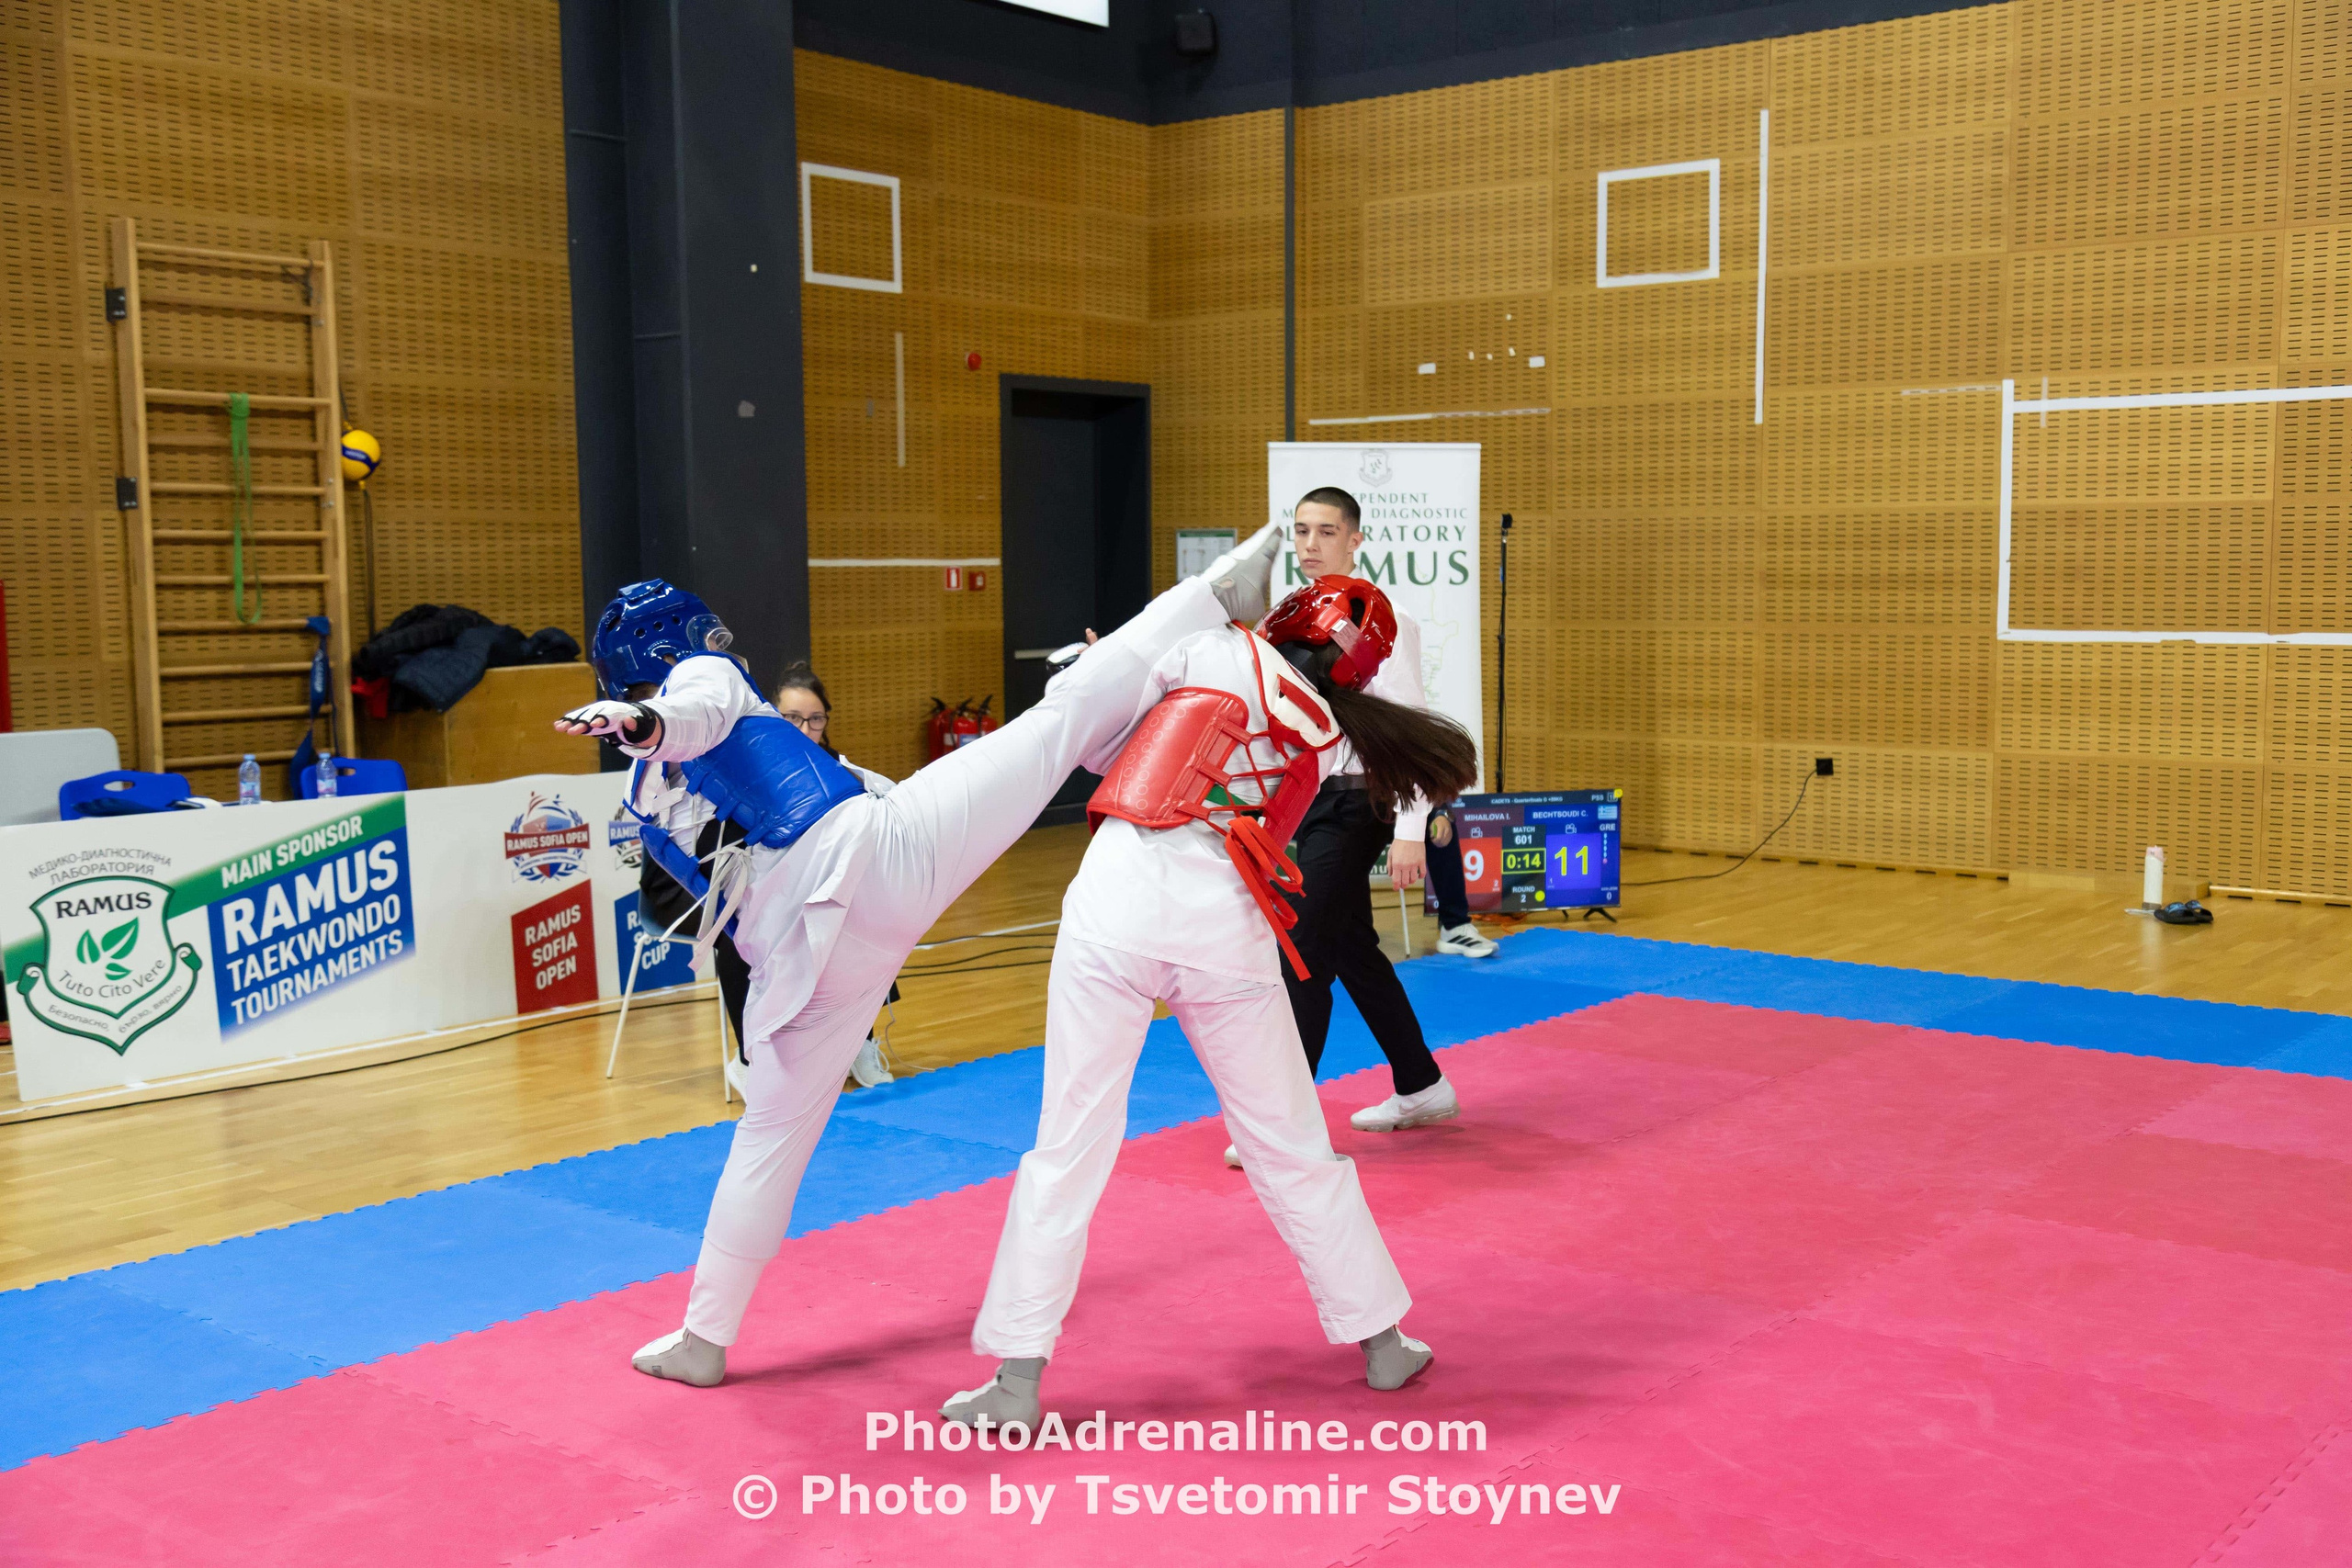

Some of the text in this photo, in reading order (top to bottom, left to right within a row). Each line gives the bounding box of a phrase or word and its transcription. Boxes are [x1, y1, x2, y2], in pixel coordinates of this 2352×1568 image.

[1351, 492, 1428, 504] PENDENT
[1372, 508, 1468, 519] DIAGNOSTIC
[1286, 525, 1466, 542] LRATORY
[1285, 549, 1469, 586] RMUS
[1464, 813, 1505, 821] MIHAILOVA
[1532, 809, 1589, 819] BECHTSOUDI C.
[1600, 823, 1616, 831] GRE
[220, 815, 364, 889] MAIN SPONSOR
[506, 830, 589, 851] RAMUS SOFIA OPEN
[1515, 834, 1532, 844] 601
[28, 848, 172, 879] МЕДИКО-ДИАГНОСТИЧНА
[50, 862, 155, 886] ЛАБОРАТОРИЯ
[1464, 849, 1485, 882] 9
[1507, 852, 1542, 869] 0:14
[1555, 845, 1589, 876] 11
[55, 890, 153, 919] RAMUS
[221, 840, 399, 955] RAMUS
[1520, 894, 1527, 903] 2
[1606, 891, 1612, 900] 0
[525, 904, 582, 947] RAMUS
[226, 894, 401, 992] TAEKWONDO
[532, 931, 578, 968] SOFIA
[641, 942, 671, 970] CUP
[59, 959, 165, 998] Tuto Cito Vere
[231, 929, 403, 1026] TOURNAMENTS
[536, 954, 577, 990] OPEN
[48, 1004, 110, 1032] Безопасно,
